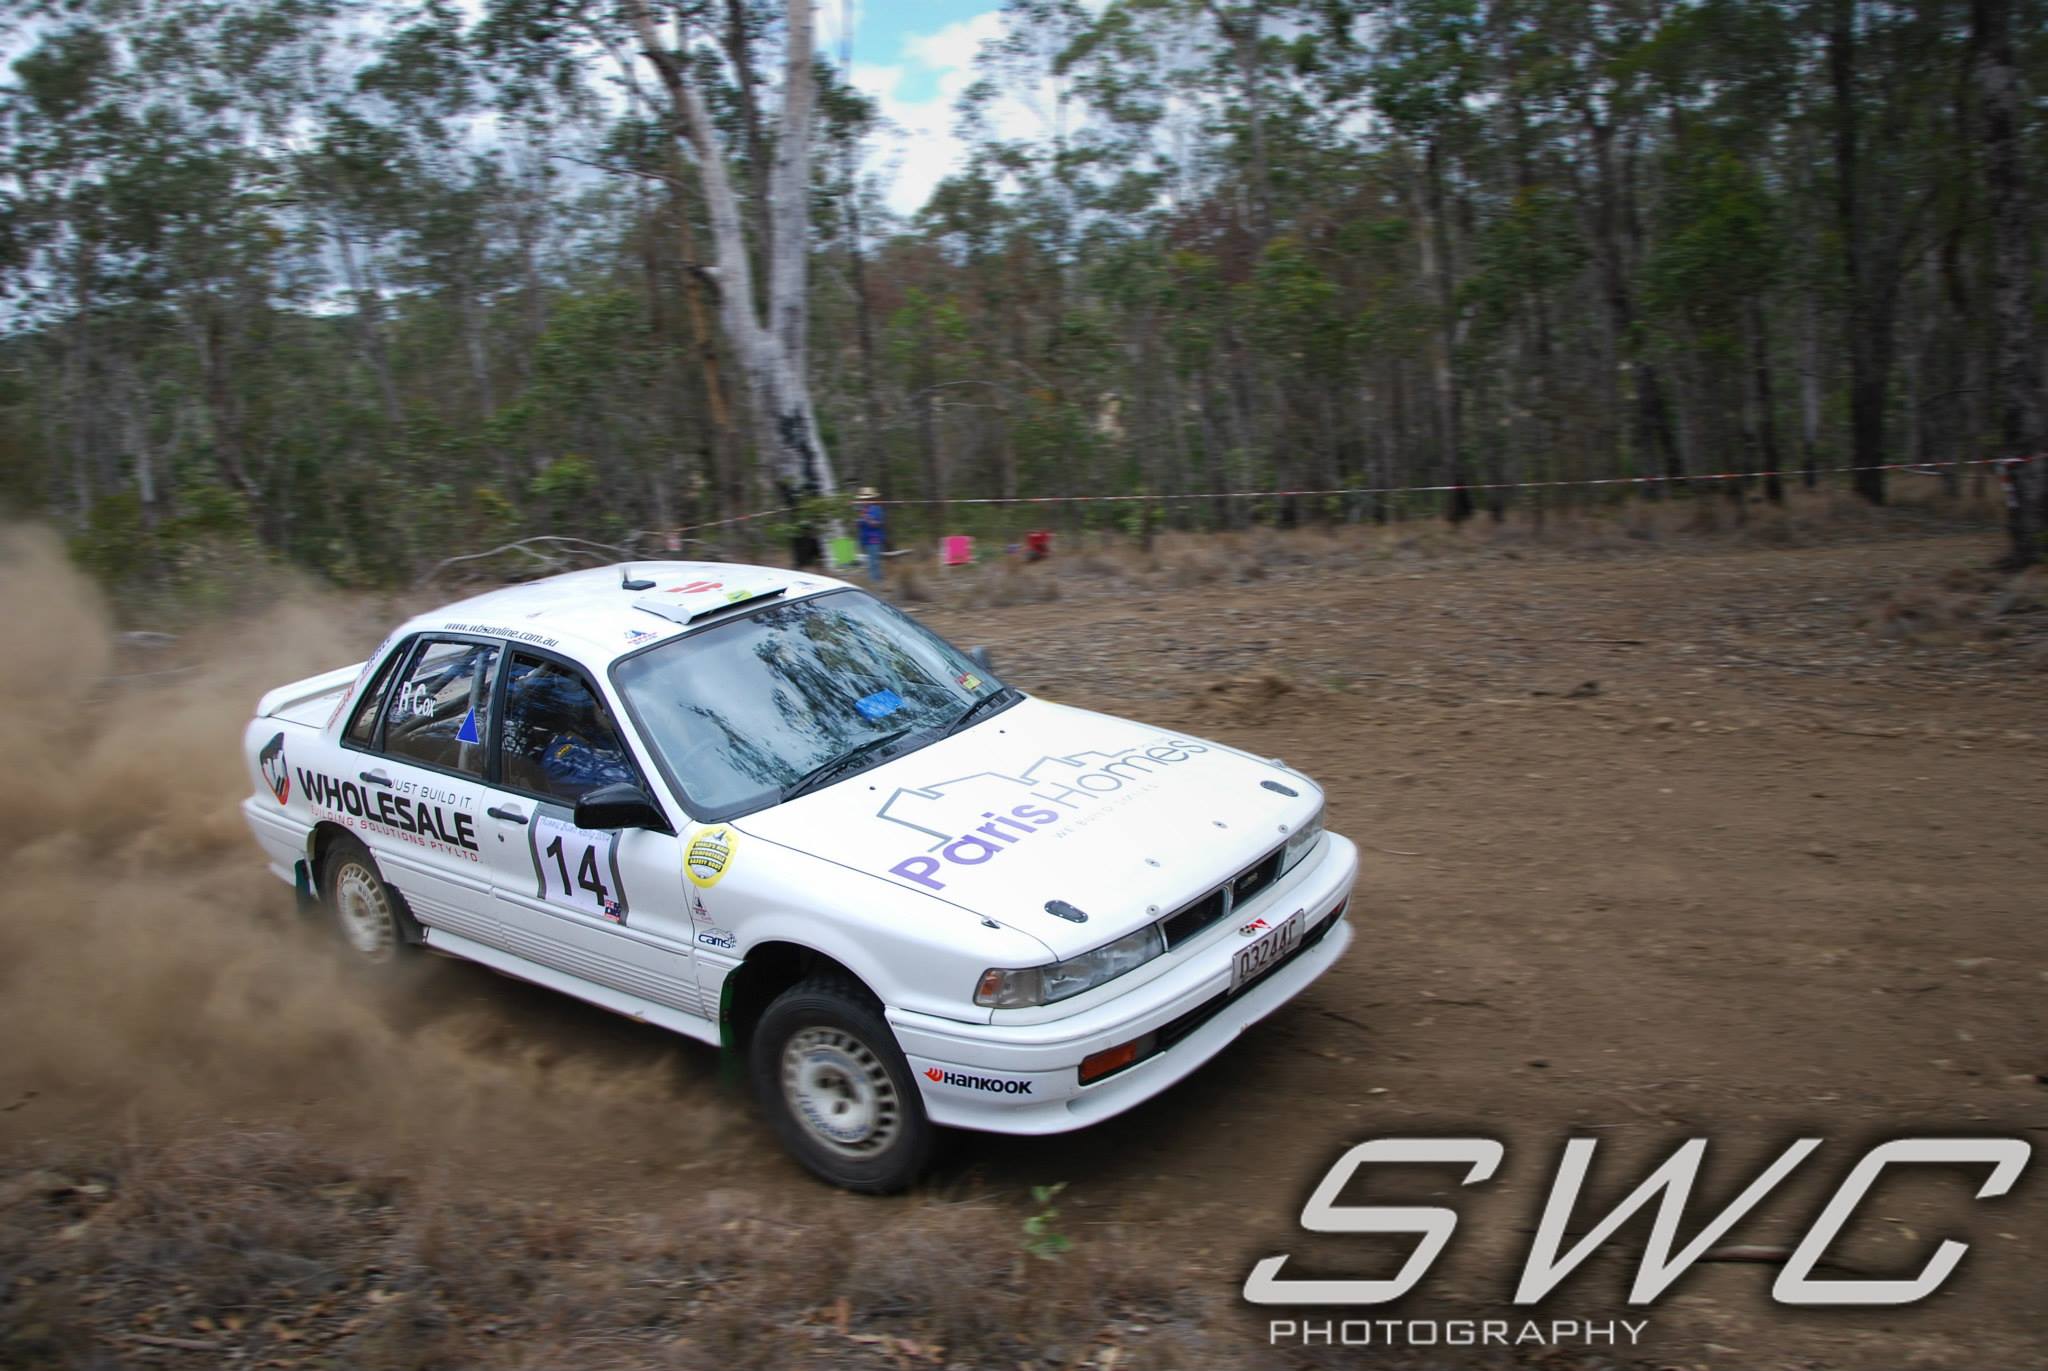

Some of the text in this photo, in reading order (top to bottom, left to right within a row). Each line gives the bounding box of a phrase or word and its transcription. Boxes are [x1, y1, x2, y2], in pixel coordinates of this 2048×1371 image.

[296, 767, 480, 851] WHOLESALE
[420, 786, 457, 805] BUILD
[360, 819, 425, 847] SOLUTIONS
[546, 835, 609, 907] 14
